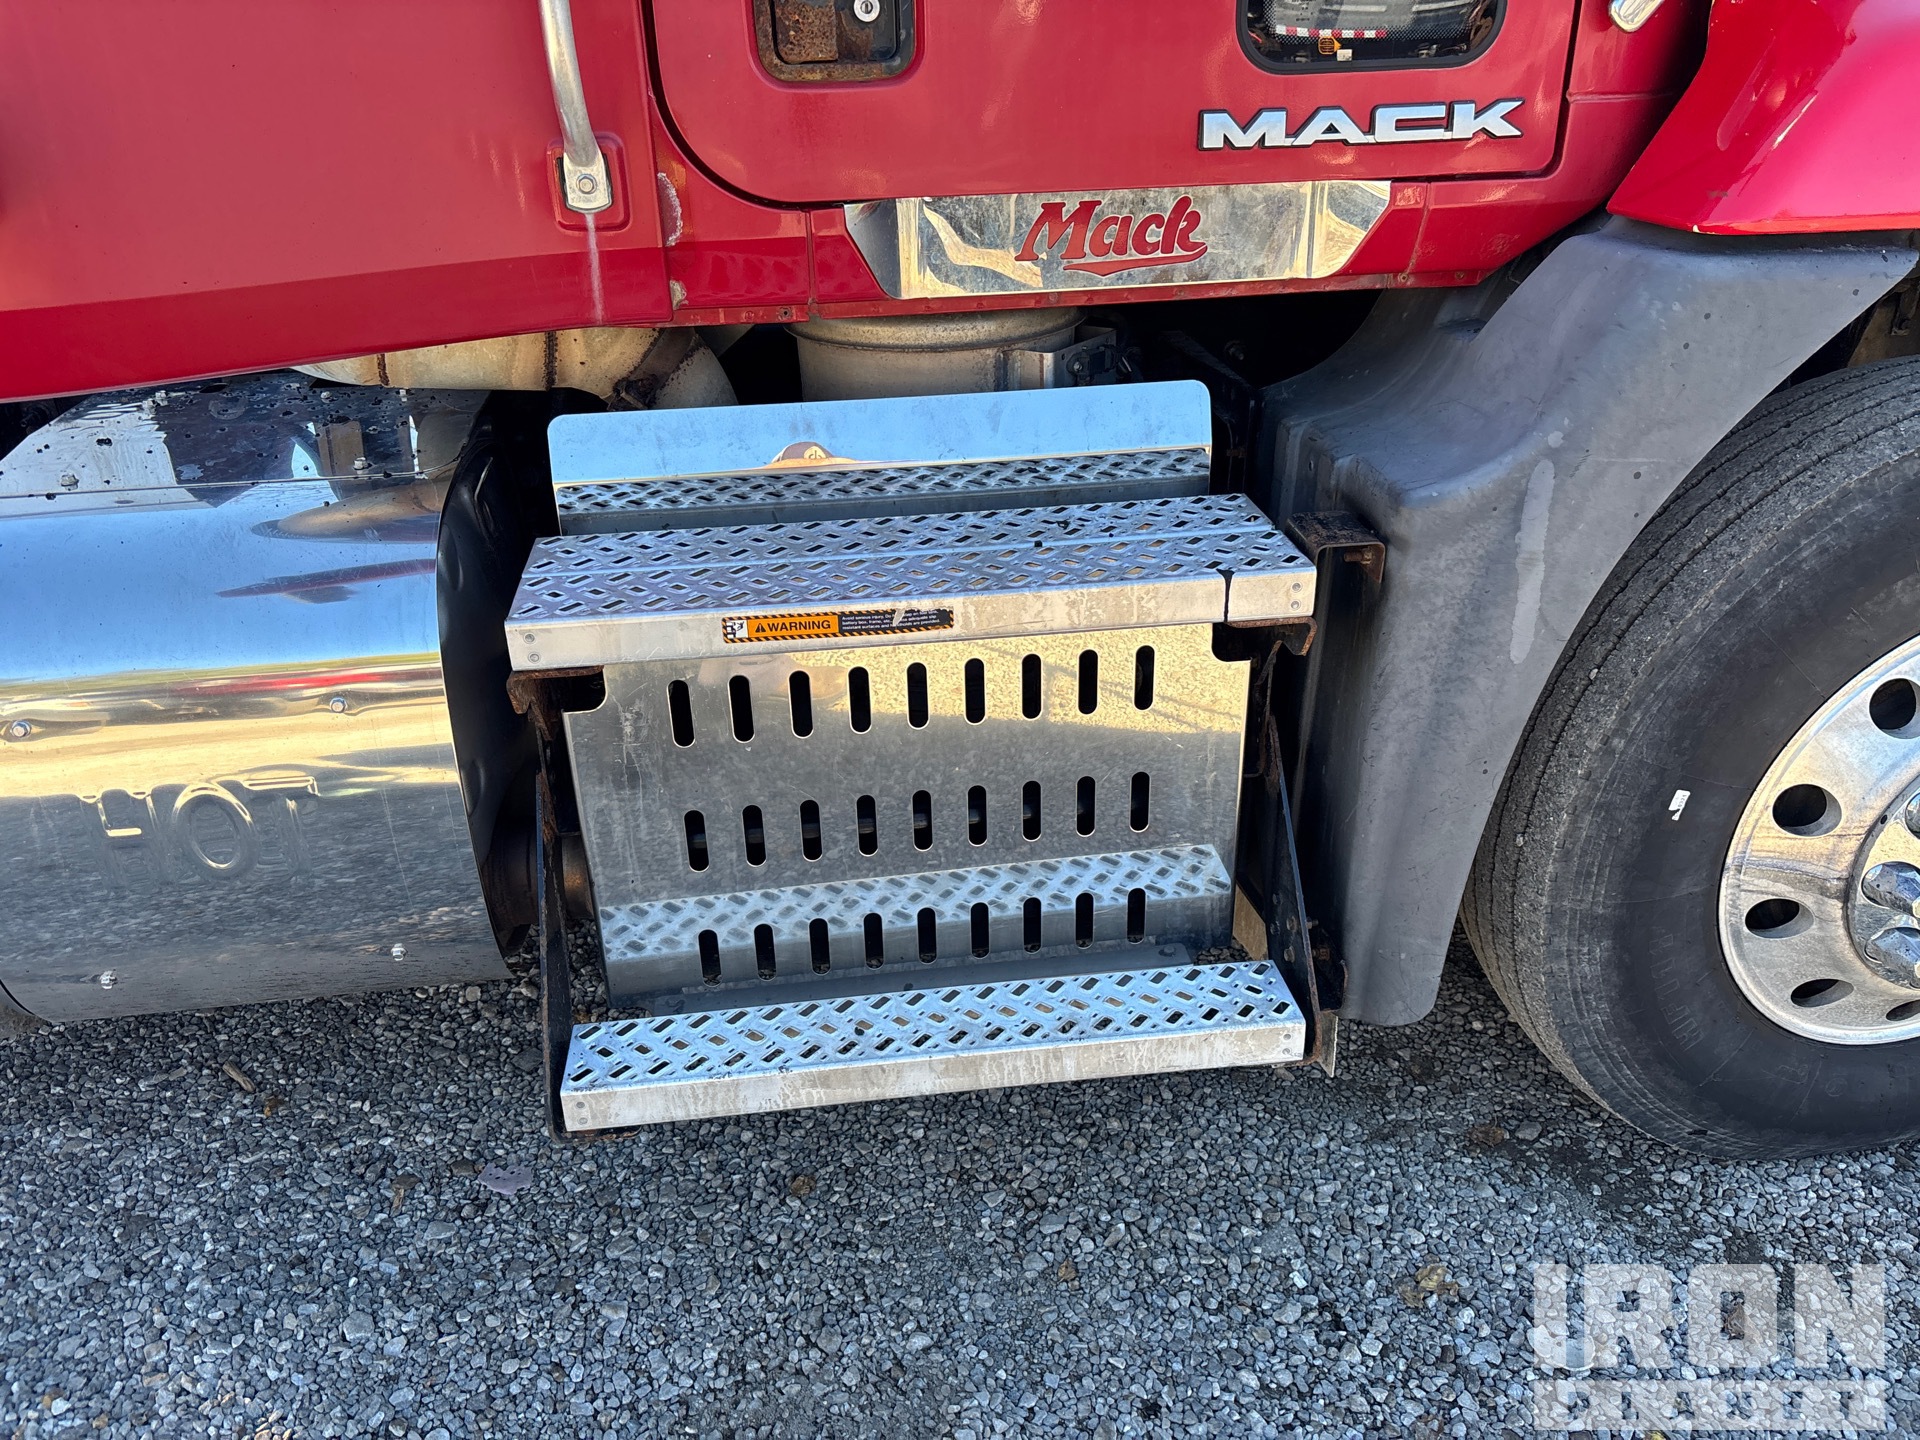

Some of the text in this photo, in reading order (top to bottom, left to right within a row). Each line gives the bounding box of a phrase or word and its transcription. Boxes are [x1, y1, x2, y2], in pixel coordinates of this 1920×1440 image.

[1200, 98, 1524, 150] MACK
[1014, 195, 1208, 266] Mack
[767, 620, 831, 632] WARNING
[80, 775, 319, 888] HOT
